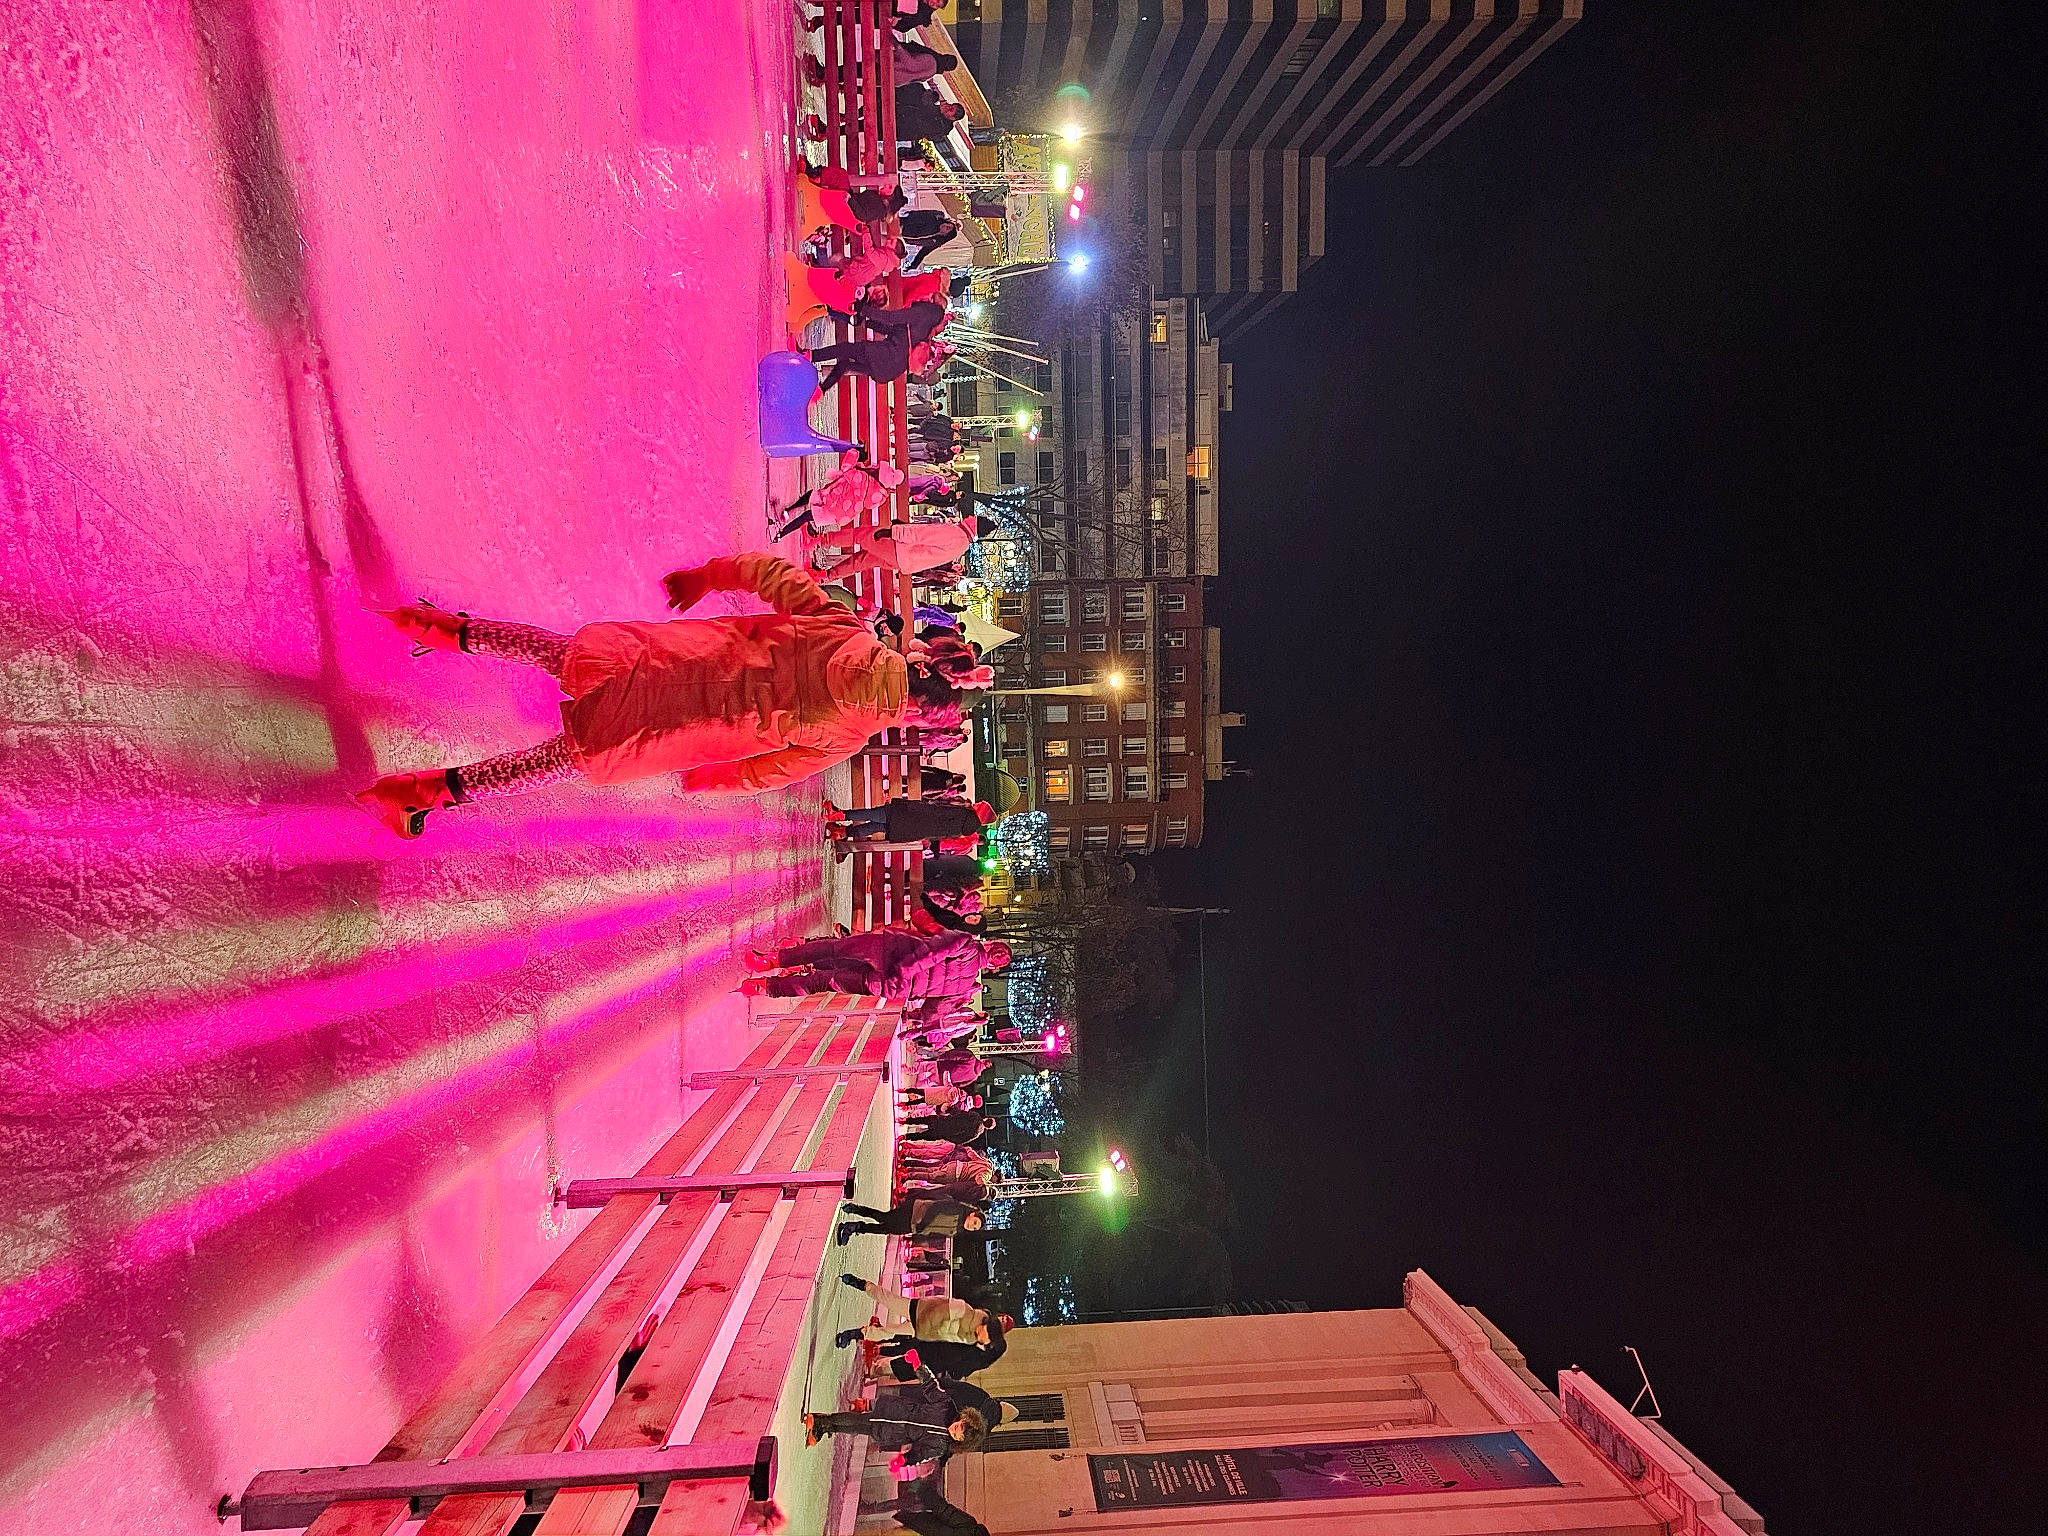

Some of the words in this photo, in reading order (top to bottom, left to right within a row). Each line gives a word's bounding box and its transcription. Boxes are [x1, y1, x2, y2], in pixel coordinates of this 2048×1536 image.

[1011, 141, 1045, 258] AVANCHE
[1230, 1472, 1241, 1480] DE
[1342, 1450, 1384, 1488] POTTER
[1364, 1448, 1410, 1486] HARRY
[1405, 1444, 1444, 1486] EXPOSITION
[1235, 1480, 1248, 1496] VILLE
